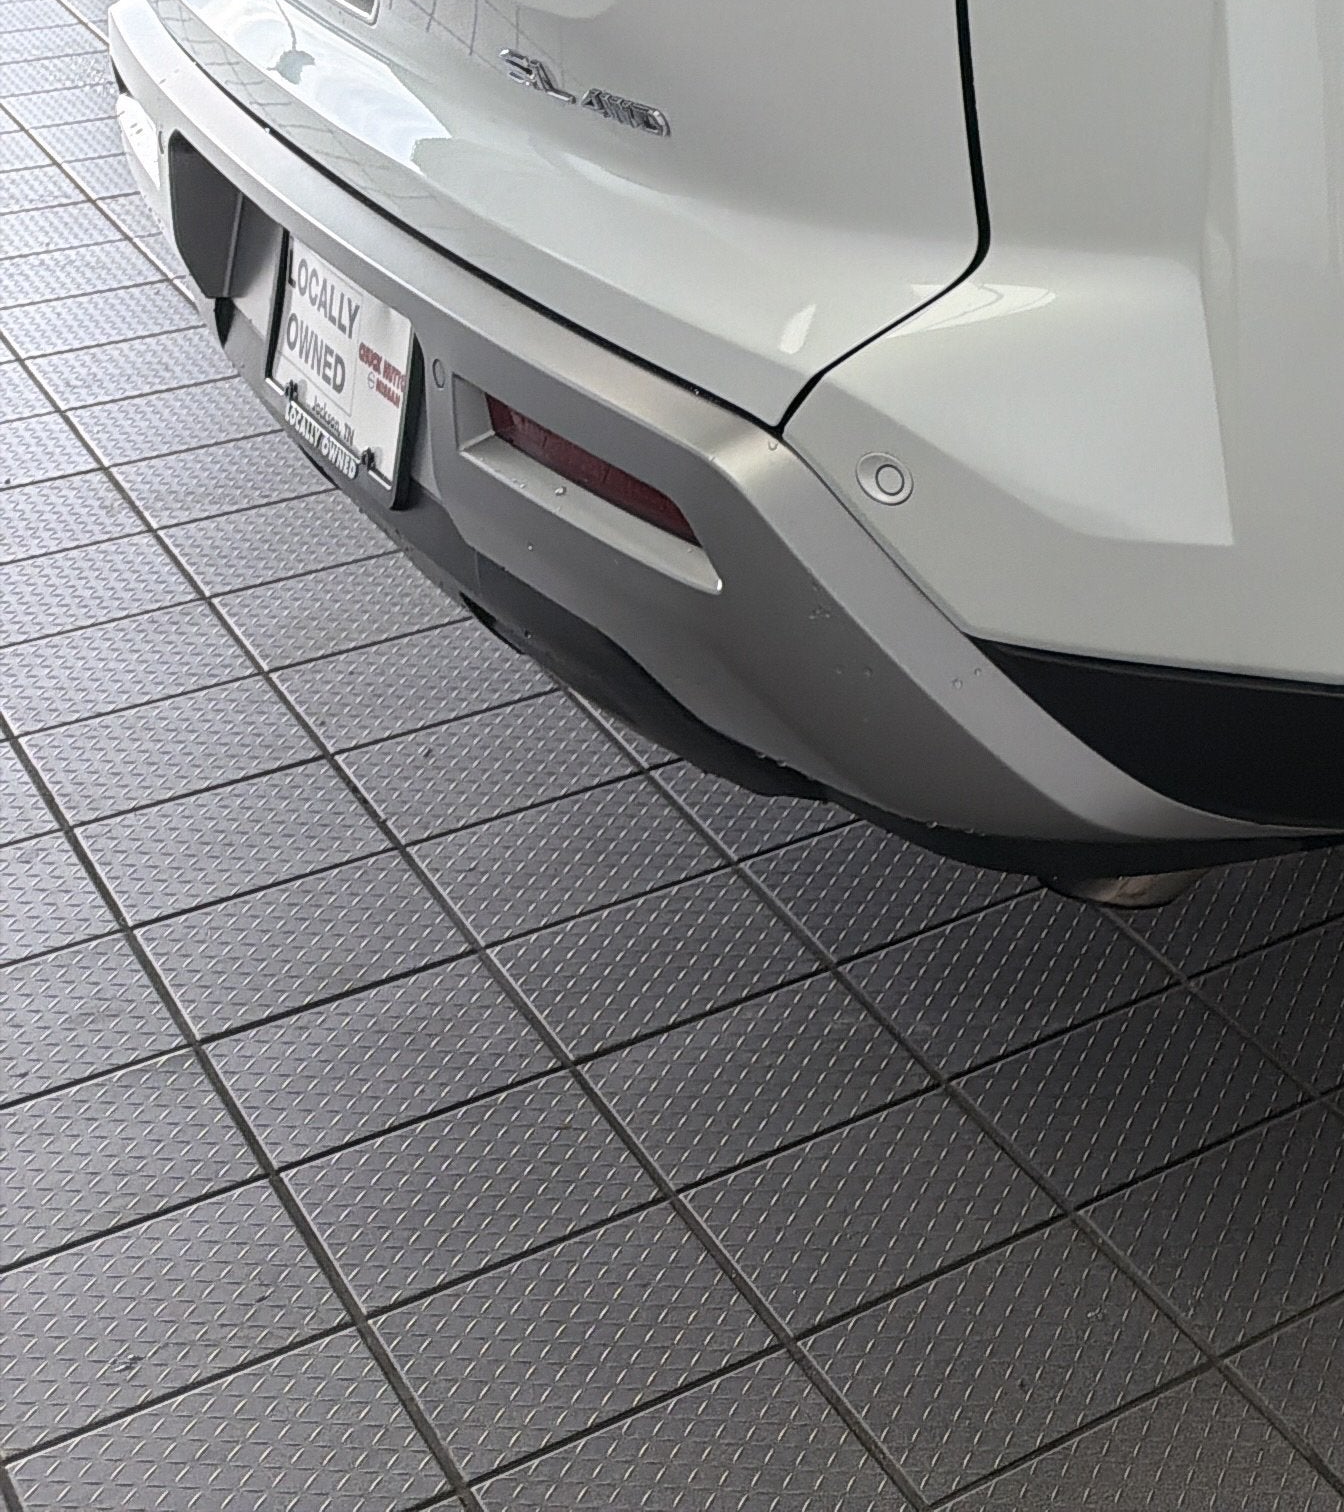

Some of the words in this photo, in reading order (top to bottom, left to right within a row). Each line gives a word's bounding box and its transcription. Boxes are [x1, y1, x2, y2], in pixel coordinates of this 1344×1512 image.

[287, 249, 360, 339] LOCALLY
[286, 313, 346, 394] OWNED
[284, 402, 321, 448] LOCALLY
[321, 436, 357, 480] OWNED
